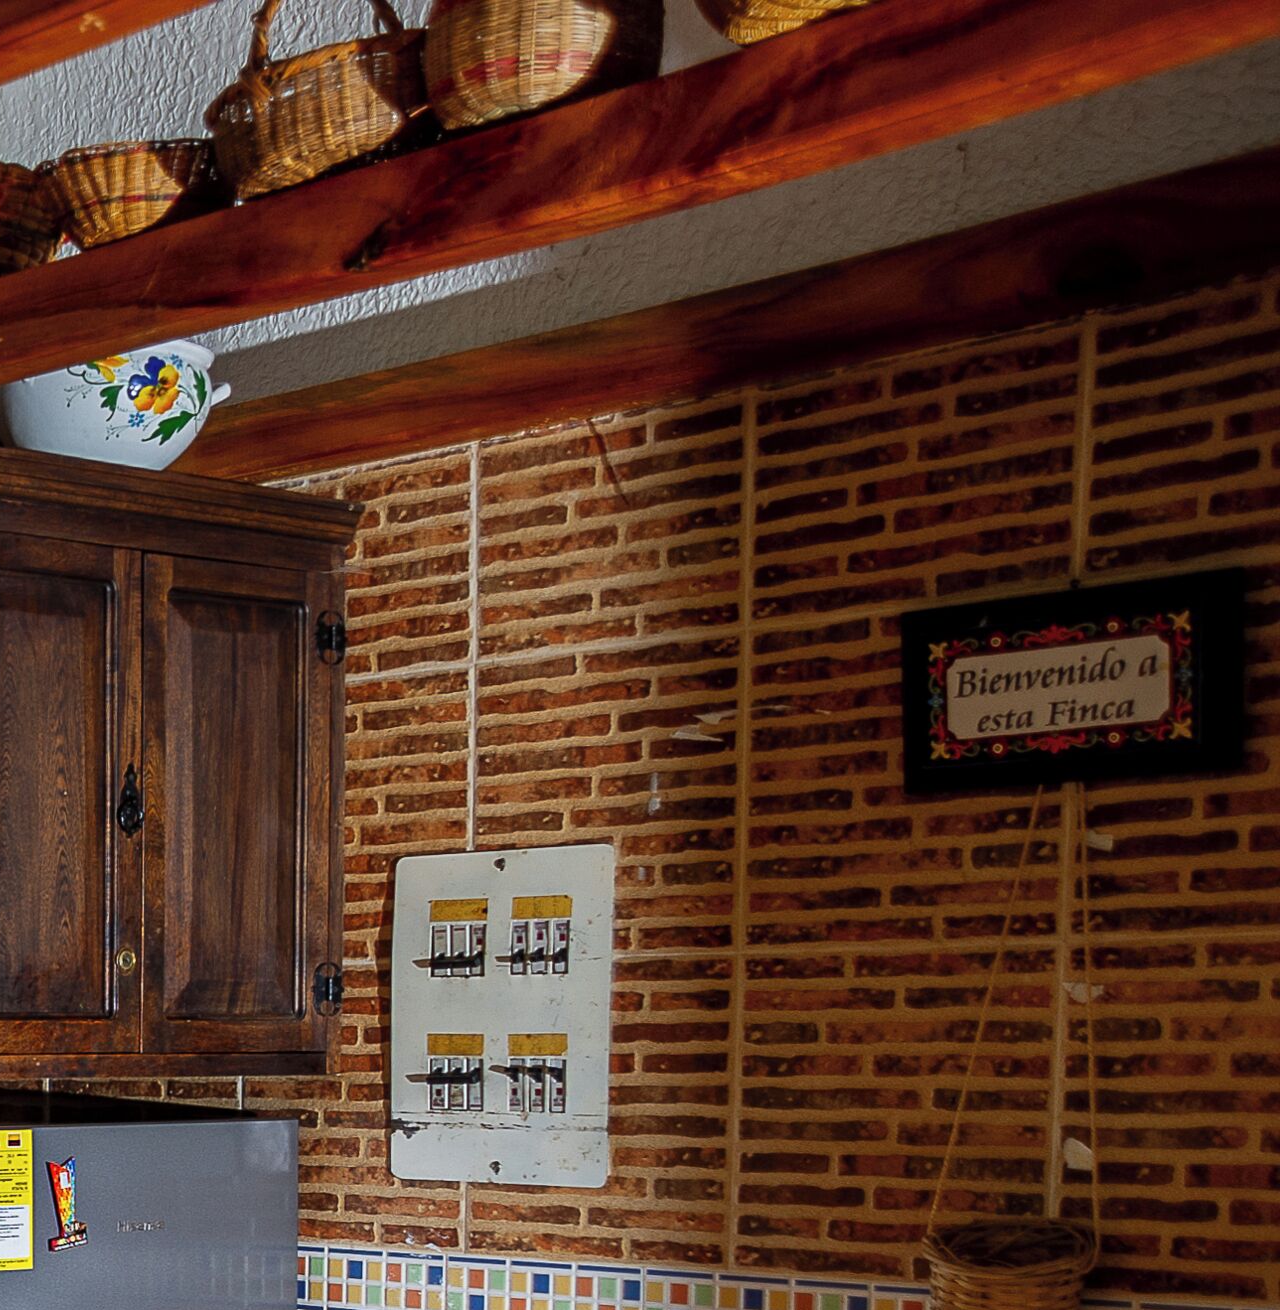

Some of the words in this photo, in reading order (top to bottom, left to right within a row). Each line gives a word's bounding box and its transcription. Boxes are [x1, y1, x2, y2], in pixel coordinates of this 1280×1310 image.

[953, 646, 1126, 699] Bienvenido
[1138, 654, 1158, 677] a
[977, 708, 1034, 733] esta
[1045, 699, 1136, 727] Finca
